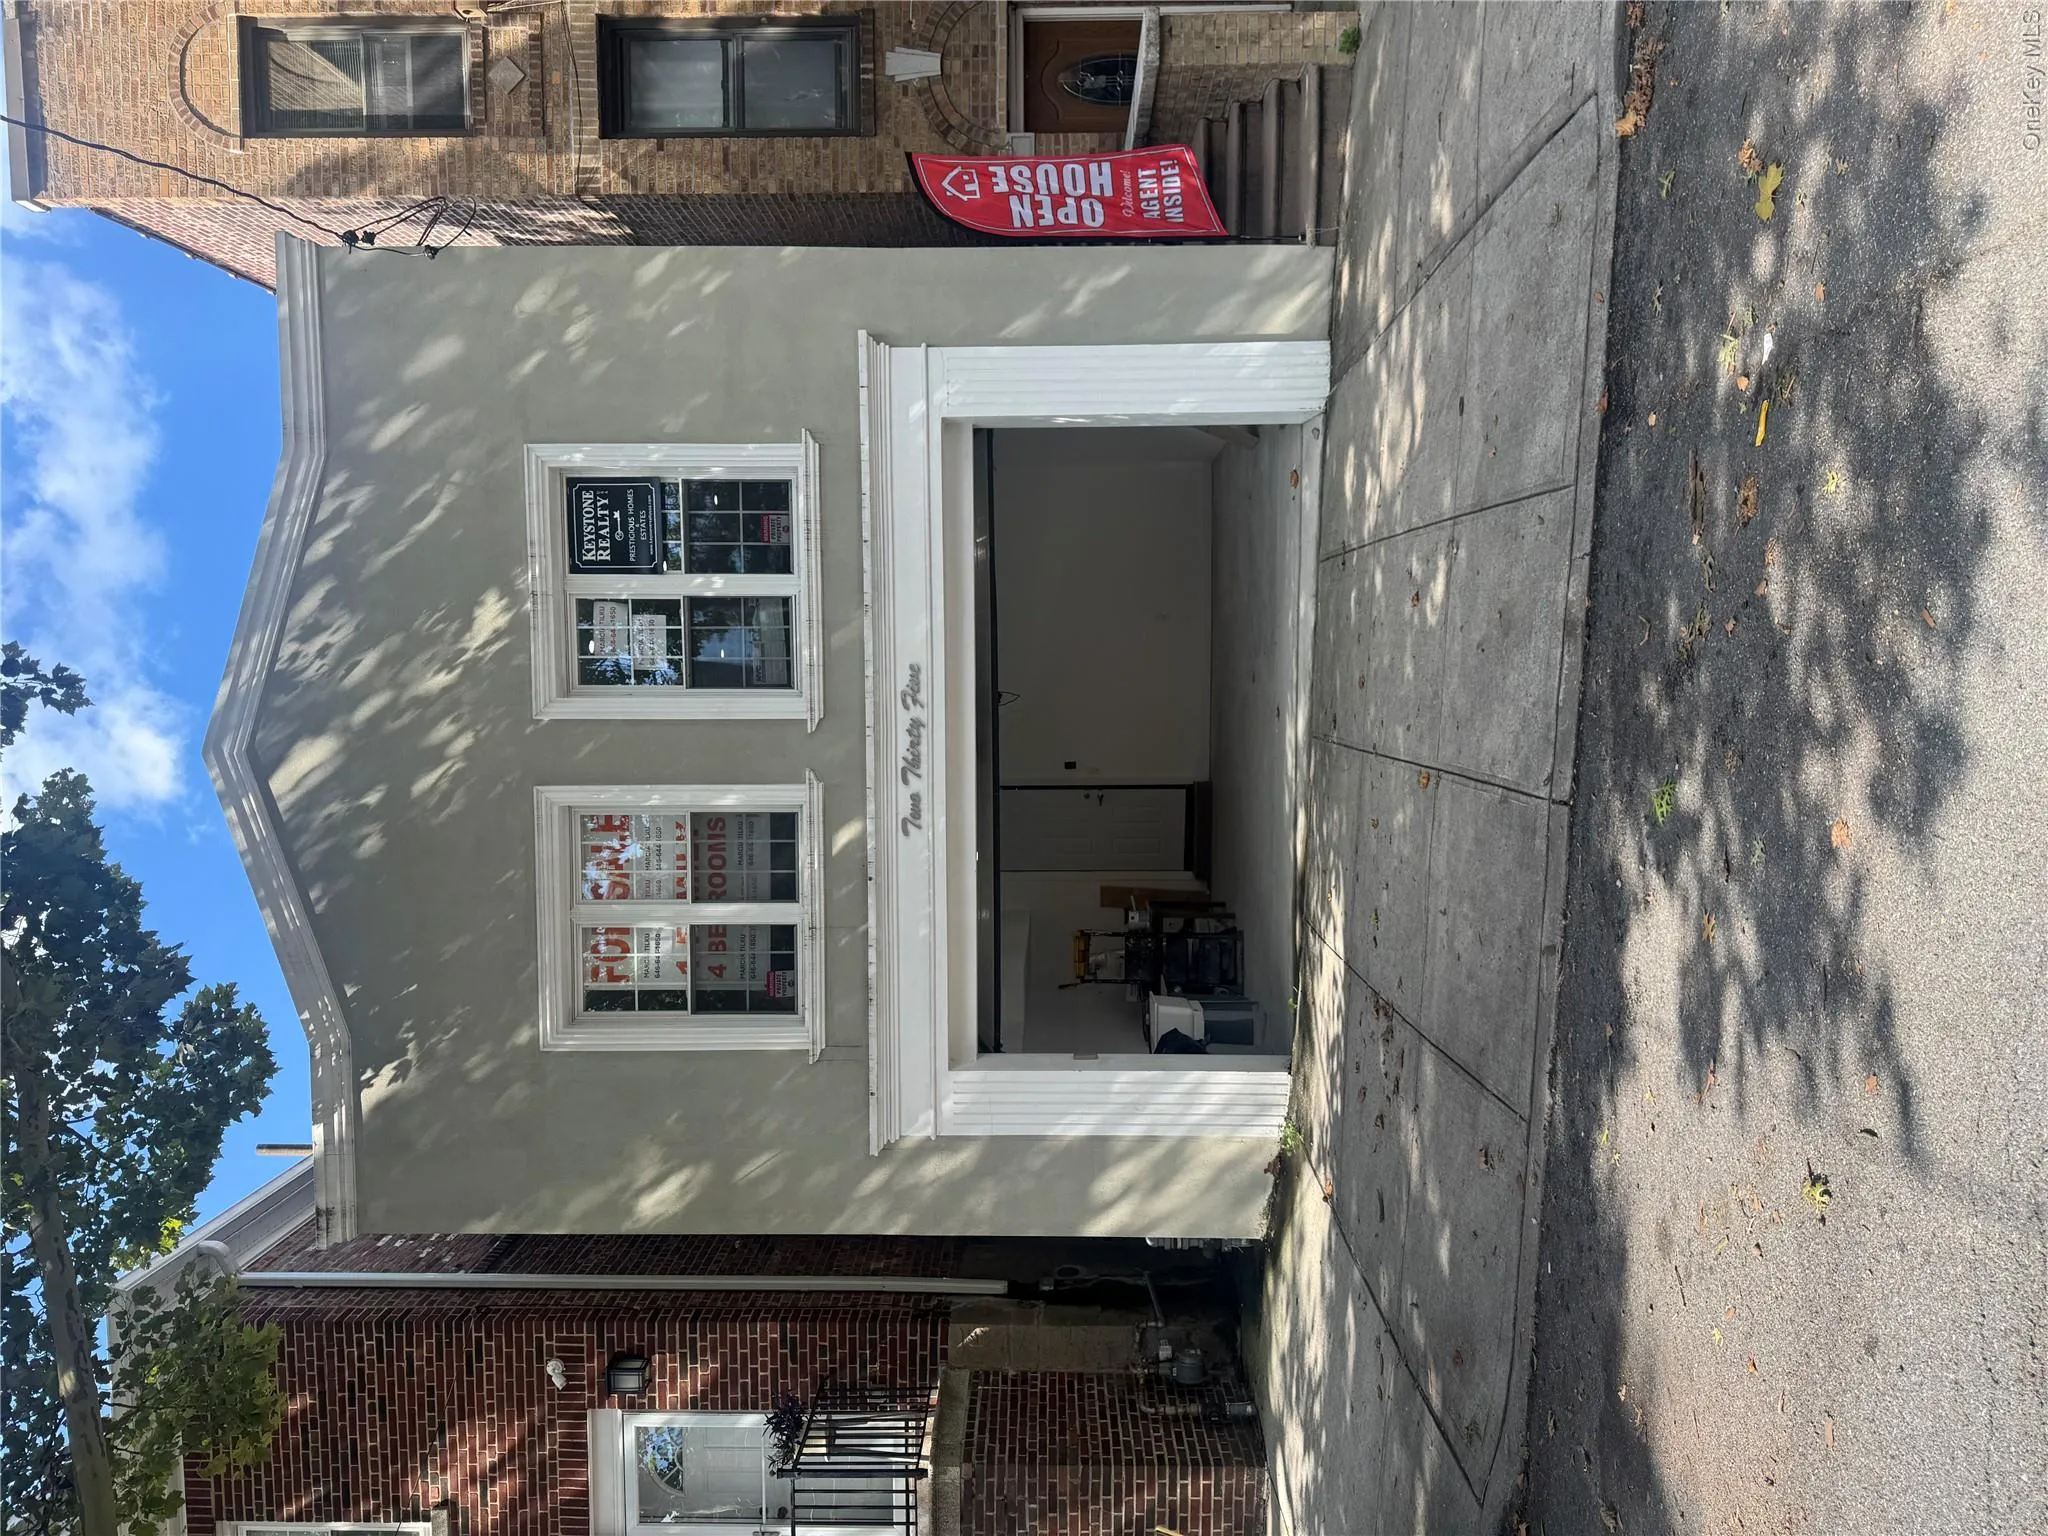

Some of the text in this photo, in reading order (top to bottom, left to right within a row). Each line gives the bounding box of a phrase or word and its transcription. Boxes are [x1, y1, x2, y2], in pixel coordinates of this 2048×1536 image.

[988, 161, 1114, 197] HOUSE
[1121, 169, 1136, 217] Welcome!
[1137, 168, 1161, 219] AGENT
[1159, 159, 1185, 223] INSIDE!
[1008, 193, 1105, 228] OPEN
[581, 490, 597, 562] KEYSTONE
[596, 496, 611, 562] REALTY
[626, 488, 636, 562] PRESTIGIOUS HOMES
[639, 510, 647, 541] ESTATES
[900, 663, 925, 838] Two Thirty Five
[706, 964, 727, 978] 4
